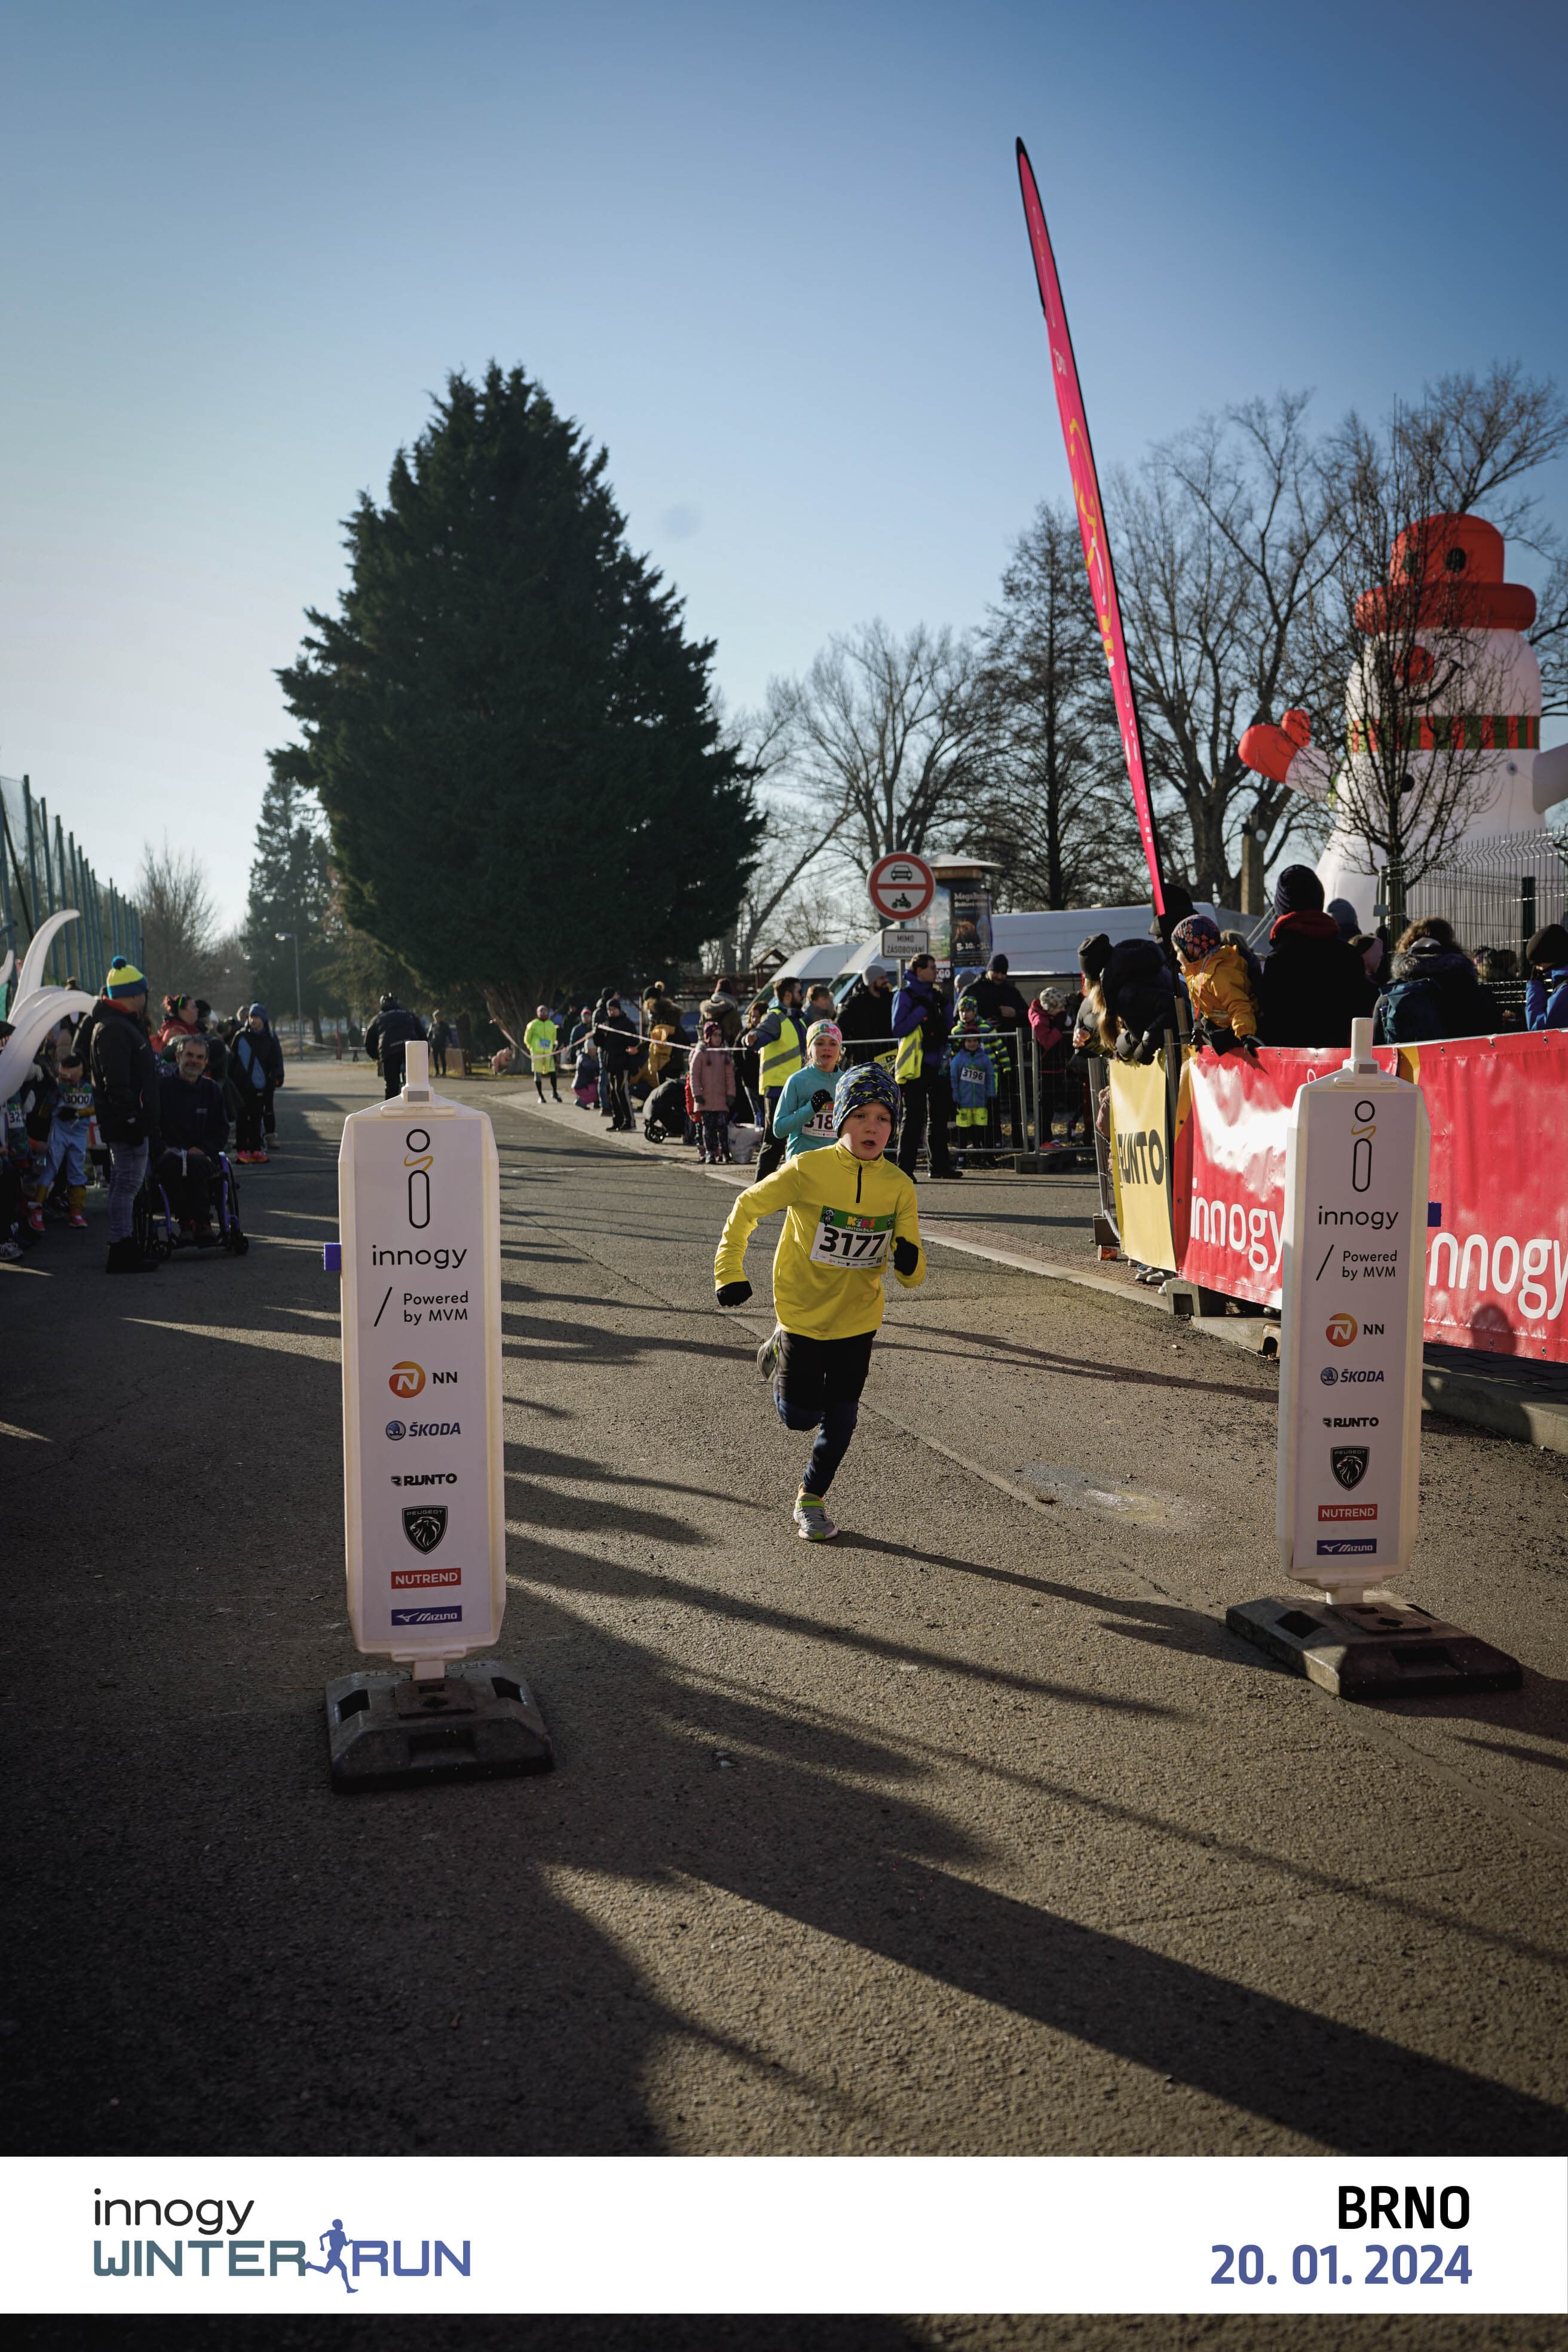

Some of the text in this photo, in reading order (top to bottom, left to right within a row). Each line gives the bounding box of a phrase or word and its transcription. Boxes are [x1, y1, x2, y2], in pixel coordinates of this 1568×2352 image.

[963, 1067, 984, 1080] 3196
[1318, 1205, 1399, 1230] innogy
[1190, 1177, 1285, 1274] innogy
[819, 1226, 886, 1258] 3177
[372, 1244, 467, 1269] innogy
[1343, 1250, 1397, 1262] Powered
[1342, 1266, 1396, 1281] by MVM
[1429, 1232, 1568, 1320] nnogy
[403, 1290, 468, 1306] Powered
[404, 1308, 468, 1326] by MVM
[1363, 1324, 1385, 1335] NN
[432, 1371, 458, 1385] NN
[1340, 1368, 1385, 1383] ŠKODA
[408, 1421, 461, 1437] ŠKODA
[1333, 1417, 1379, 1428] RUNTO
[403, 1473, 458, 1487] RUNTO
[1321, 1508, 1375, 1518] NUTREND
[395, 1572, 458, 1585] NUTREND
